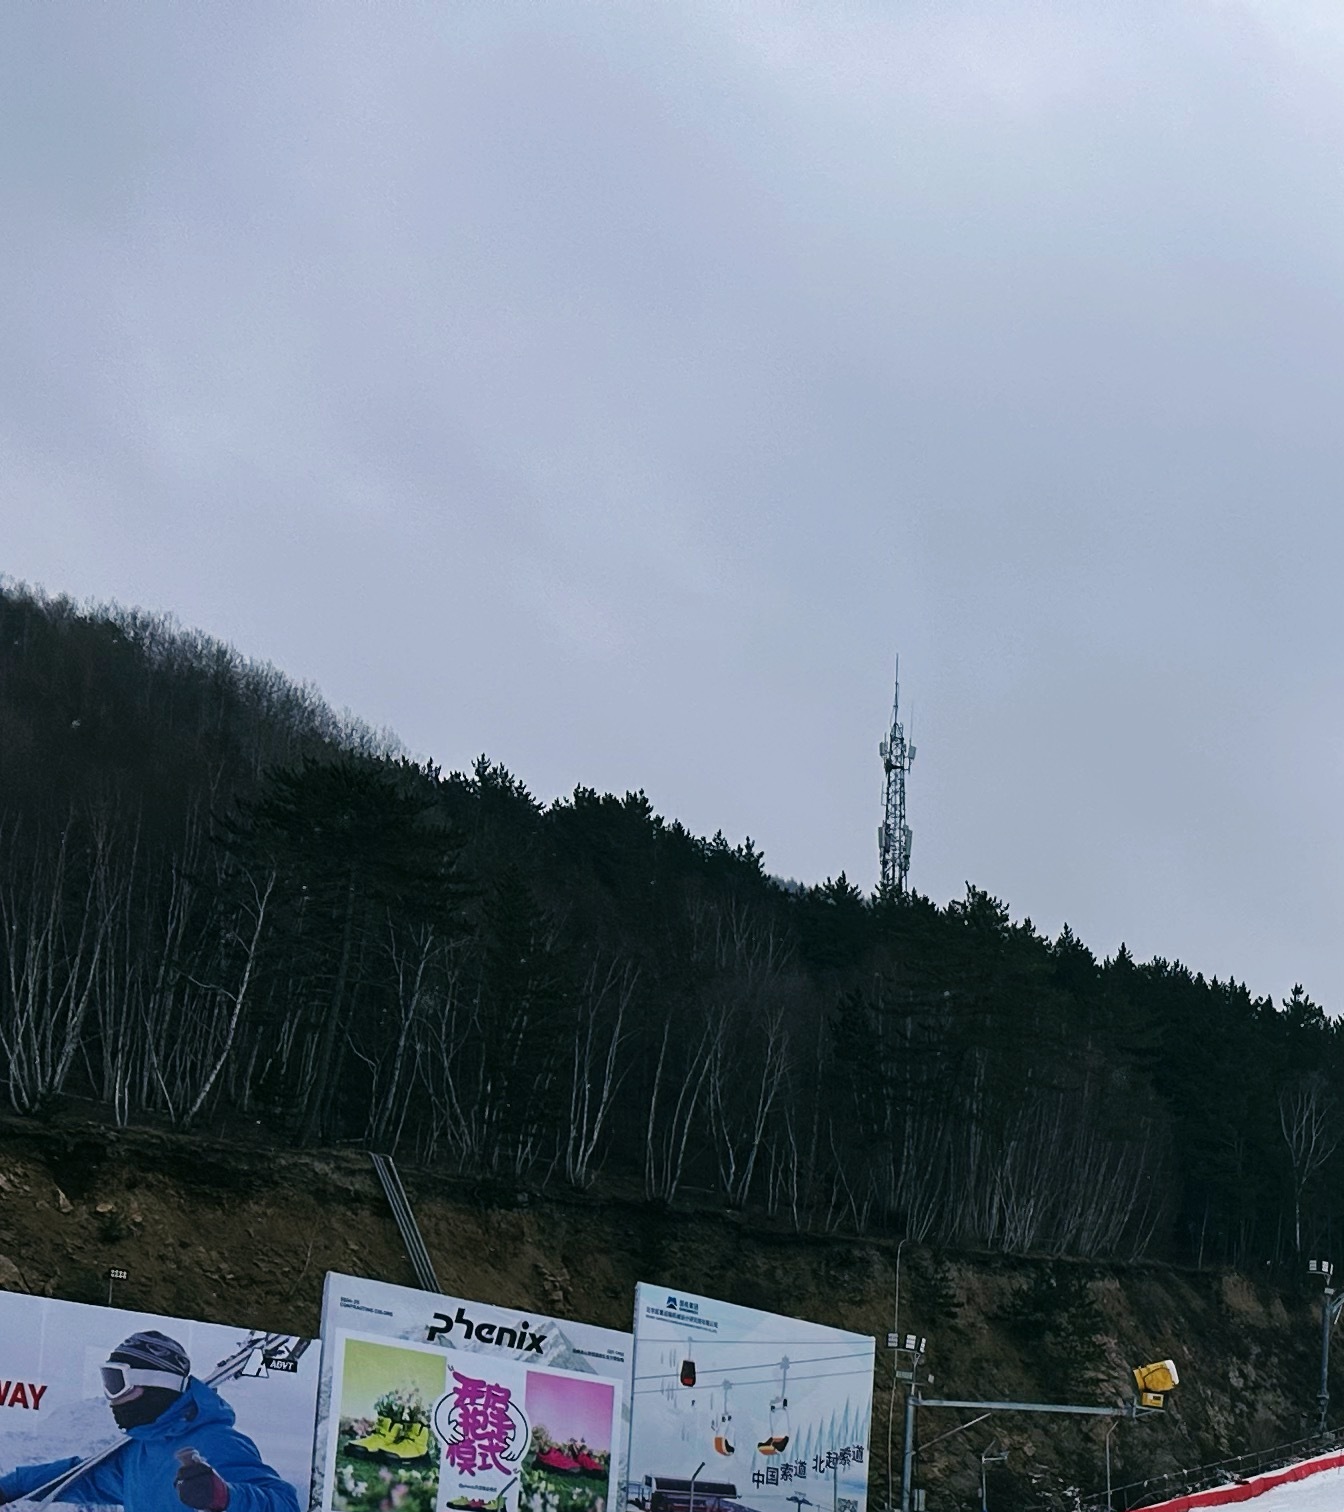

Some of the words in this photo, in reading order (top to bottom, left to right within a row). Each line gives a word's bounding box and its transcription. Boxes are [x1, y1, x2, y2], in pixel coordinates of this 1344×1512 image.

[427, 1308, 548, 1355] phenix
[752, 1458, 807, 1490] 中国索道
[812, 1444, 865, 1473] 北起索道
